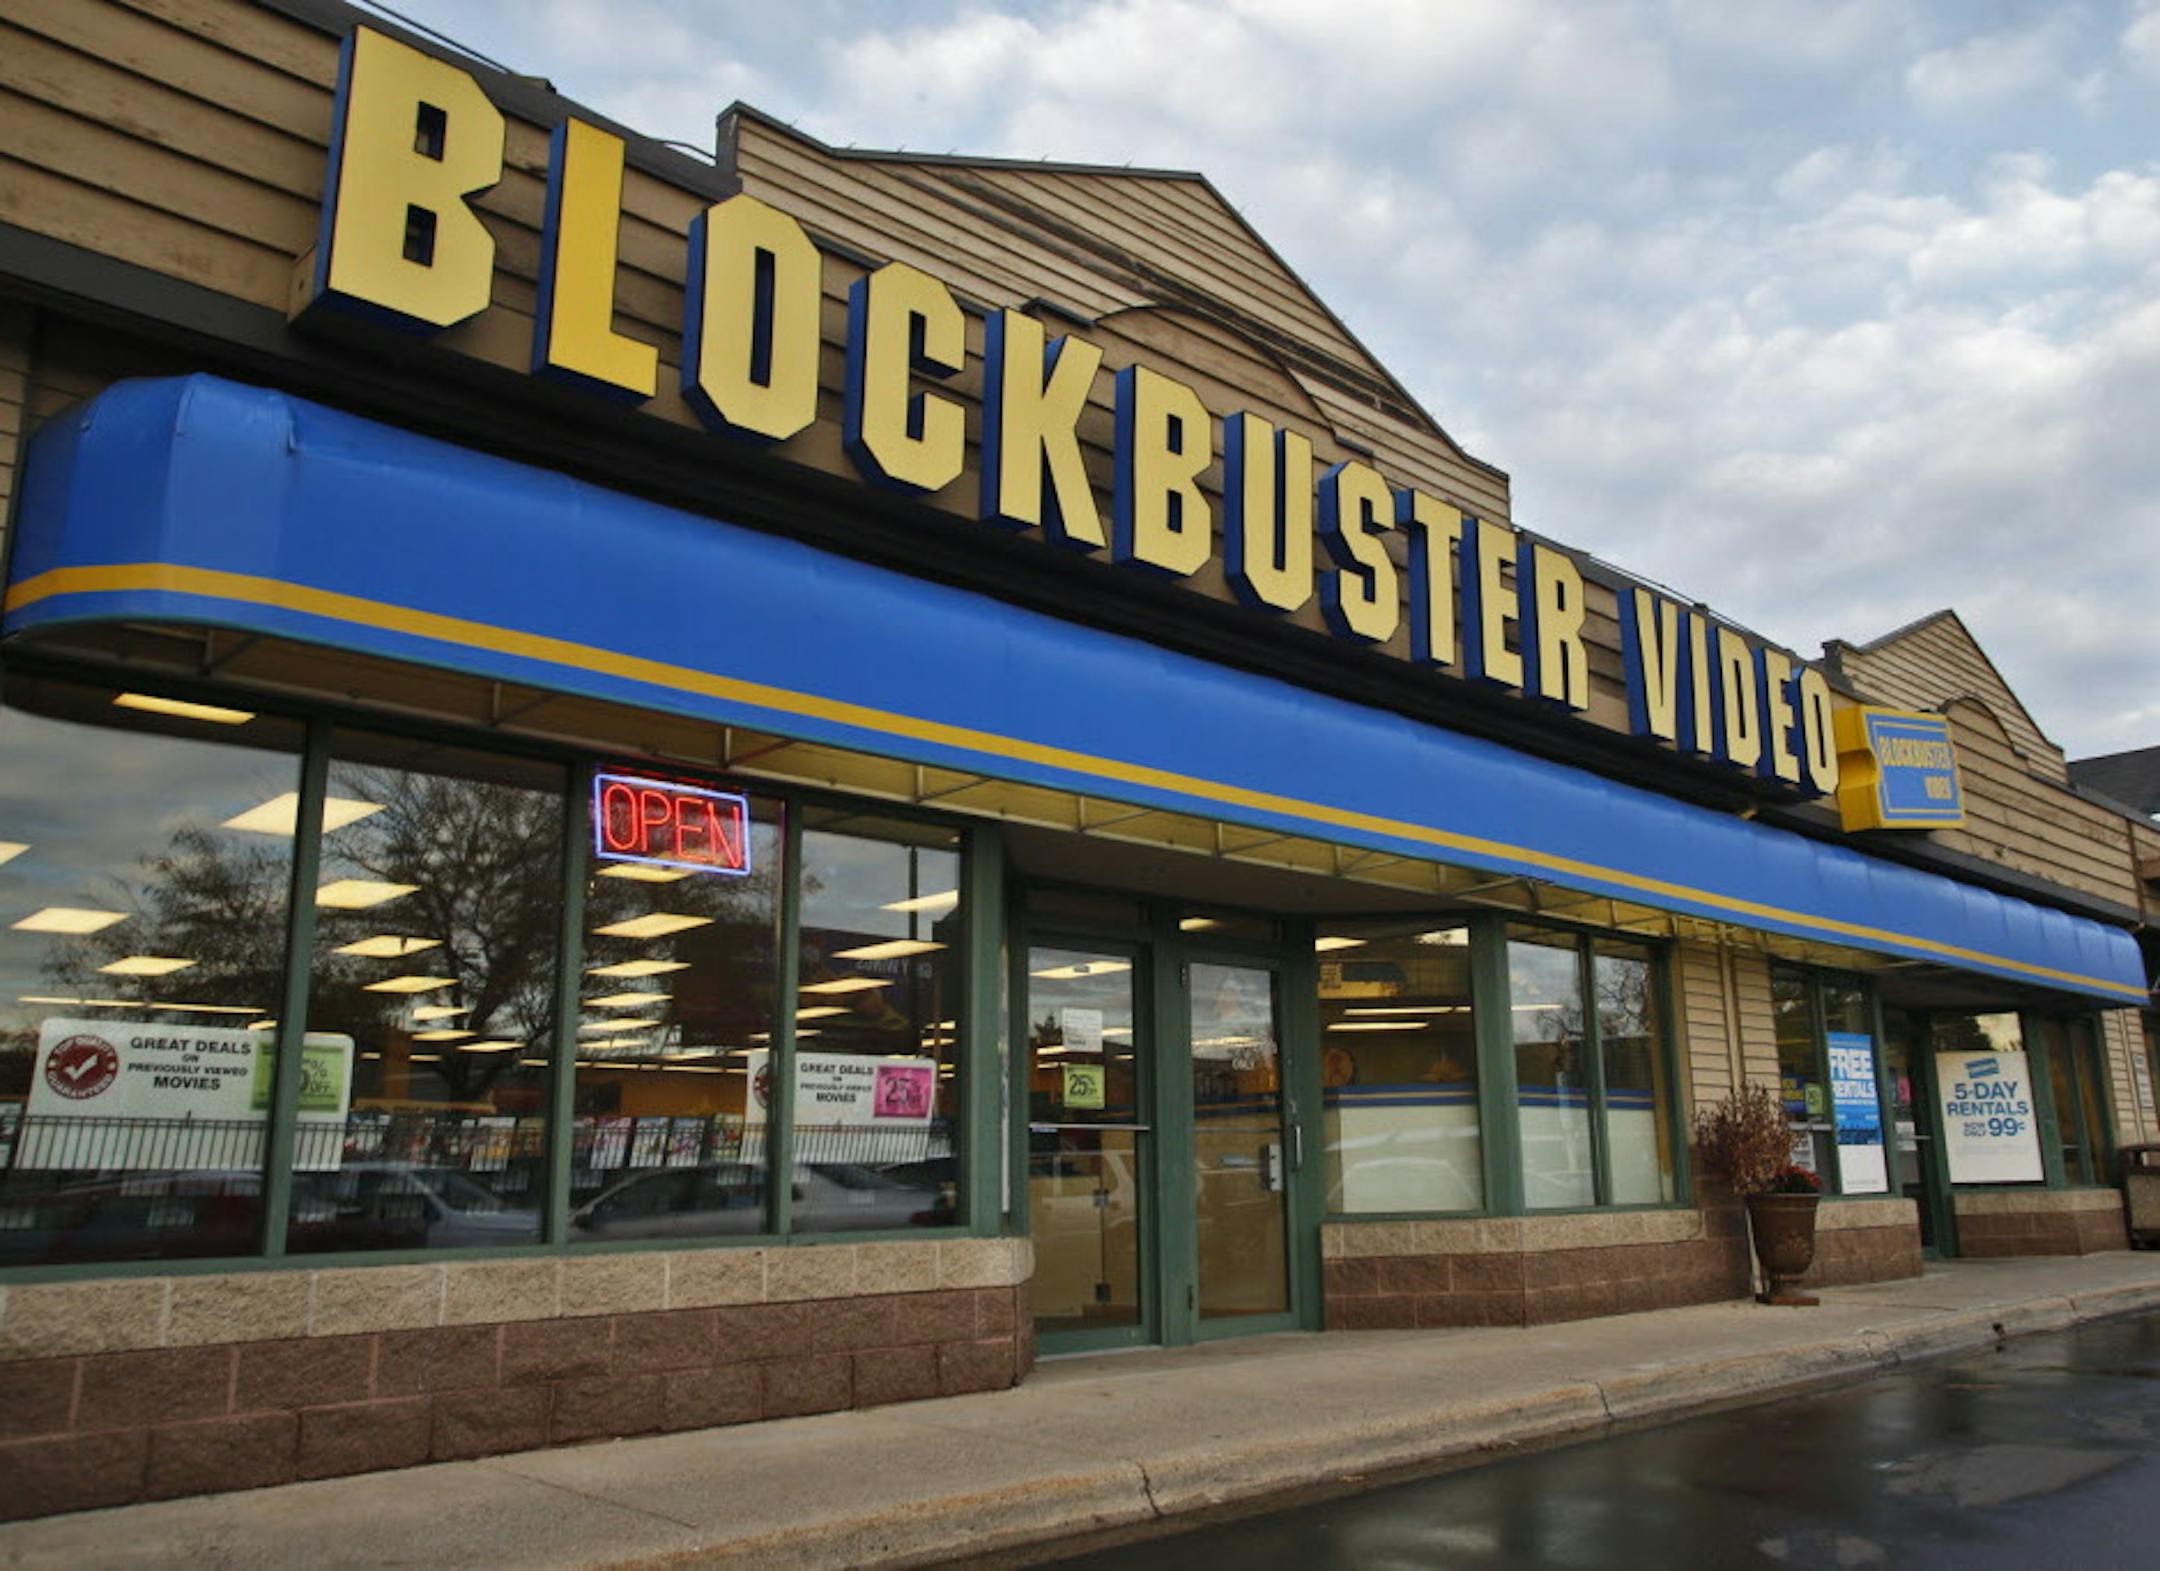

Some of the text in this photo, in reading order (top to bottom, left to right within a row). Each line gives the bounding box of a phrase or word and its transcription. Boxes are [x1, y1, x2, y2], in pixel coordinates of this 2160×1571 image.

[322, 23, 1839, 795] BLOCKBUSTER VIDEO
[603, 783, 743, 869] OPEN
[130, 1036, 252, 1055] GREAT DEALS
[182, 1054, 199, 1063] ON
[1828, 1048, 1874, 1080] FREE
[127, 1063, 249, 1077] PREVIOUSLY VIEWED
[800, 1062, 836, 1074] GREAT
[839, 1065, 874, 1076] DEALS
[153, 1076, 221, 1091] MOVIES
[310, 1081, 331, 1094] OFF
[1954, 1080, 2018, 1100] 5-DAY
[816, 1092, 856, 1103] MOVIES
[1946, 1101, 2029, 1117] RENTALS
